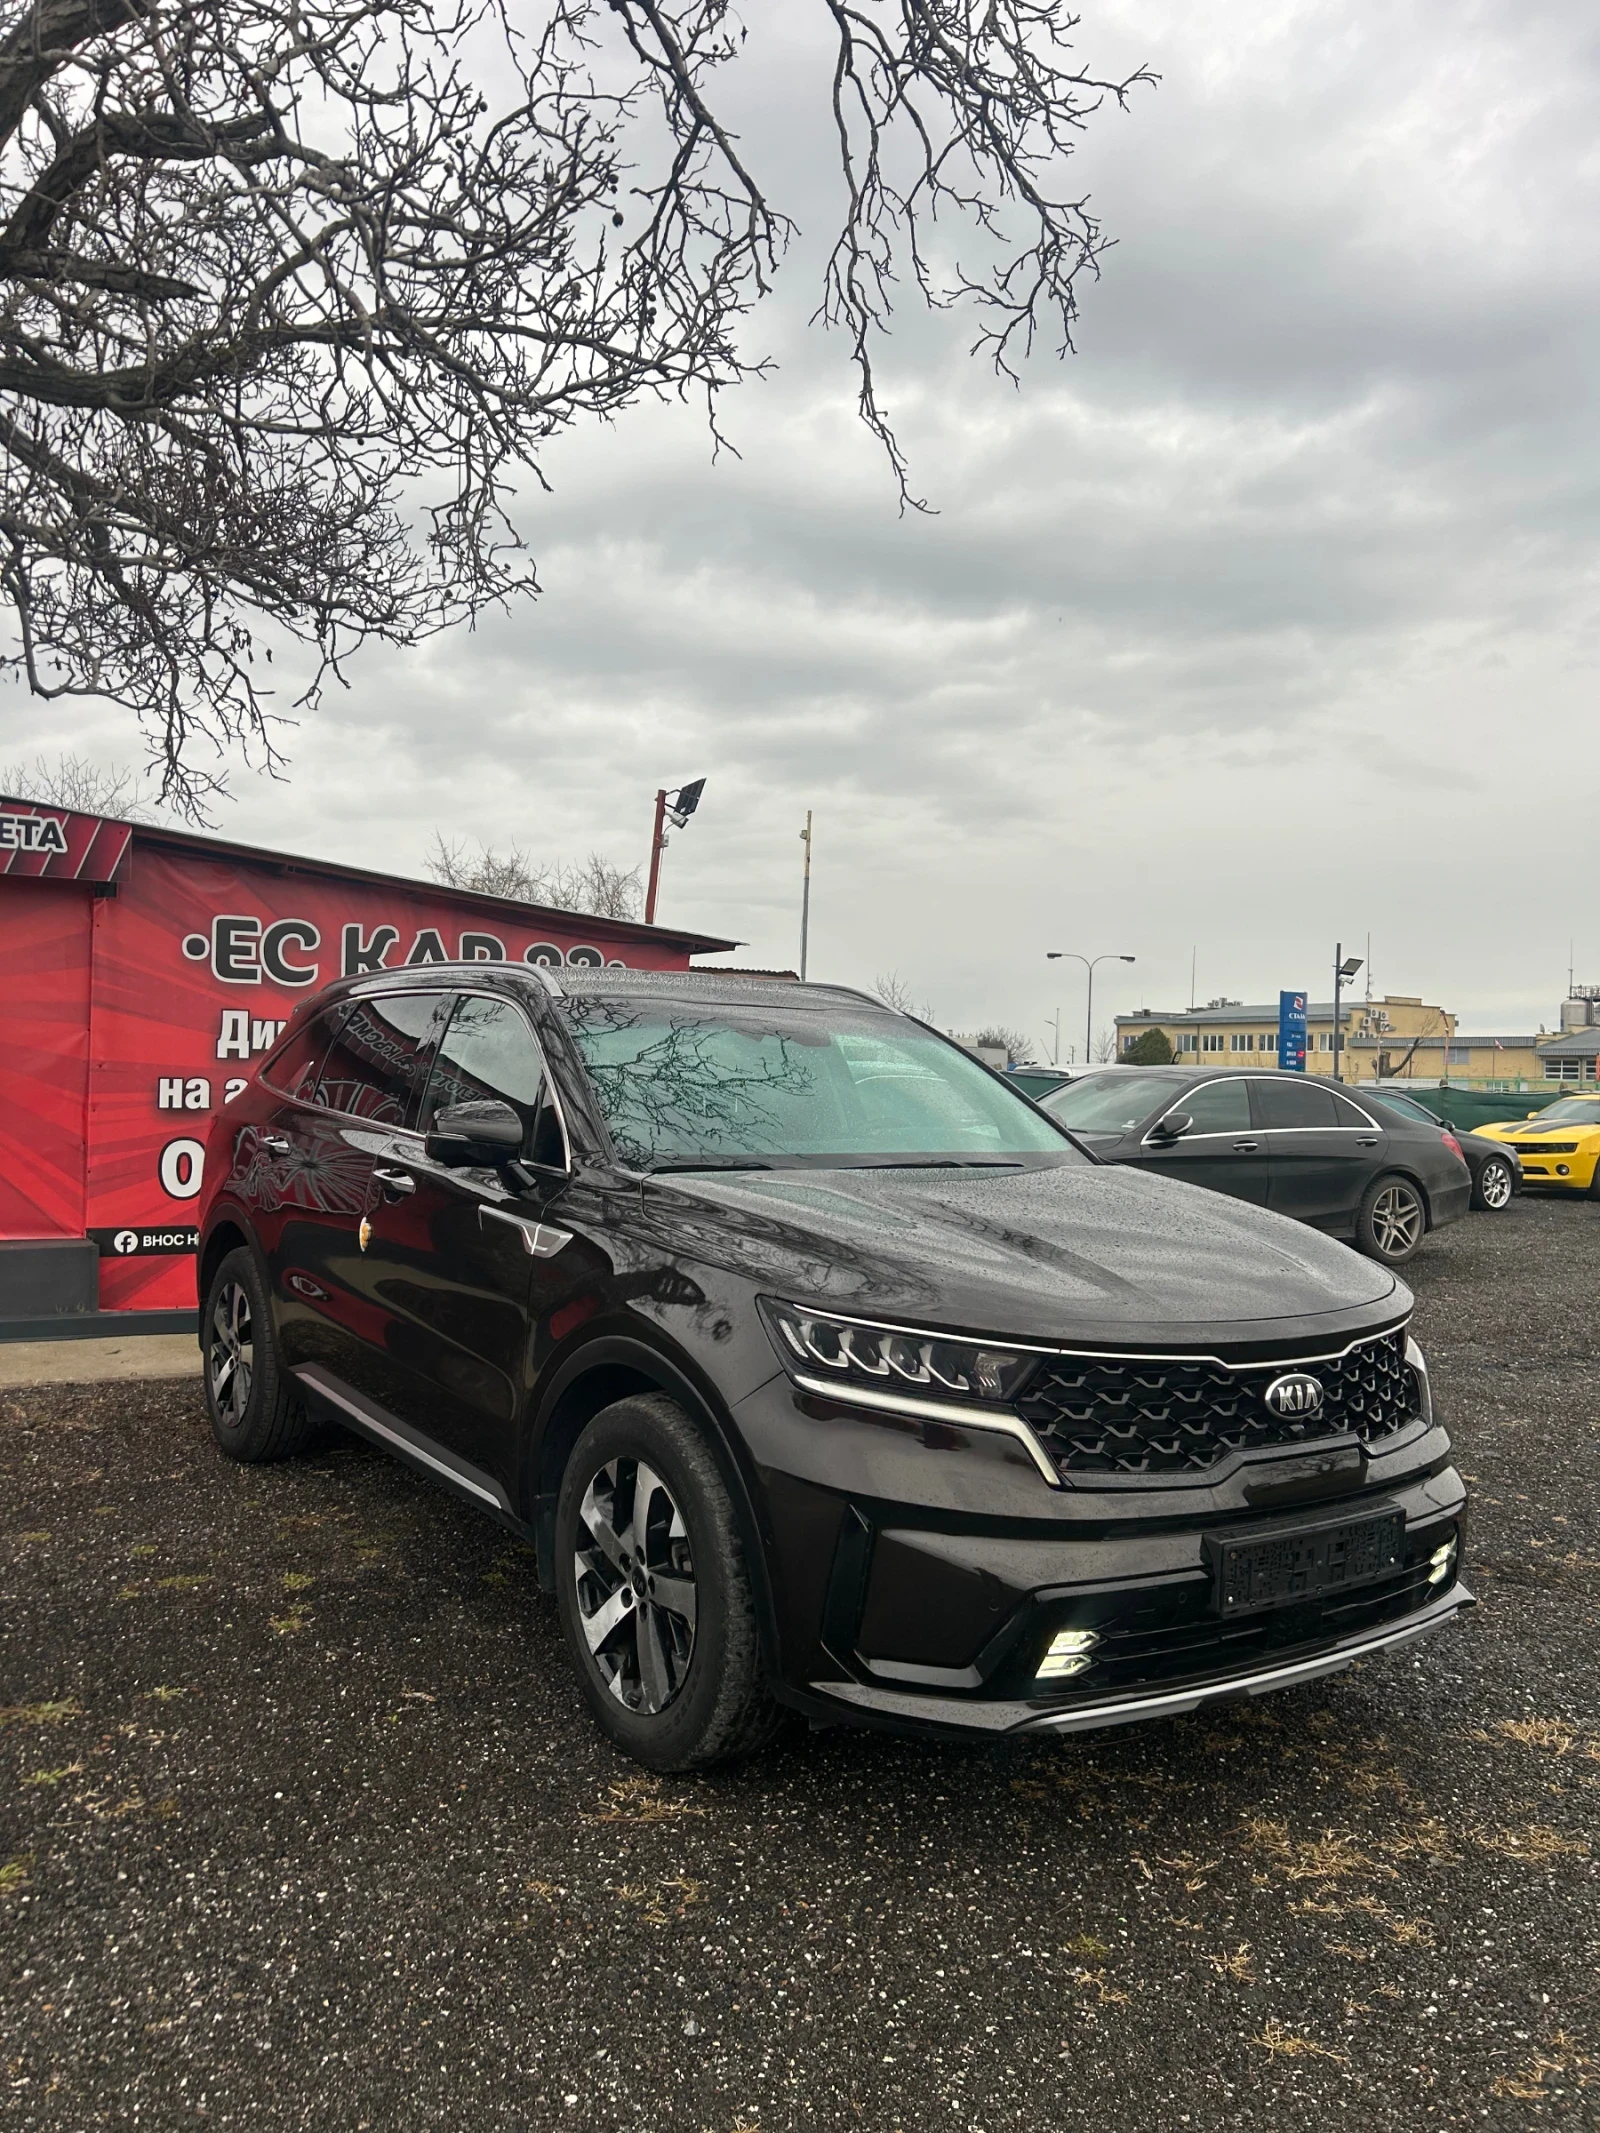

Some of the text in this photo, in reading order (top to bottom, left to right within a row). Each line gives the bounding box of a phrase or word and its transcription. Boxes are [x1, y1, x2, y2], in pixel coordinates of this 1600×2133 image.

[157, 1076, 212, 1110] на
[143, 1233, 184, 1247] ВНОС
[1277, 1383, 1318, 1412] KIA
